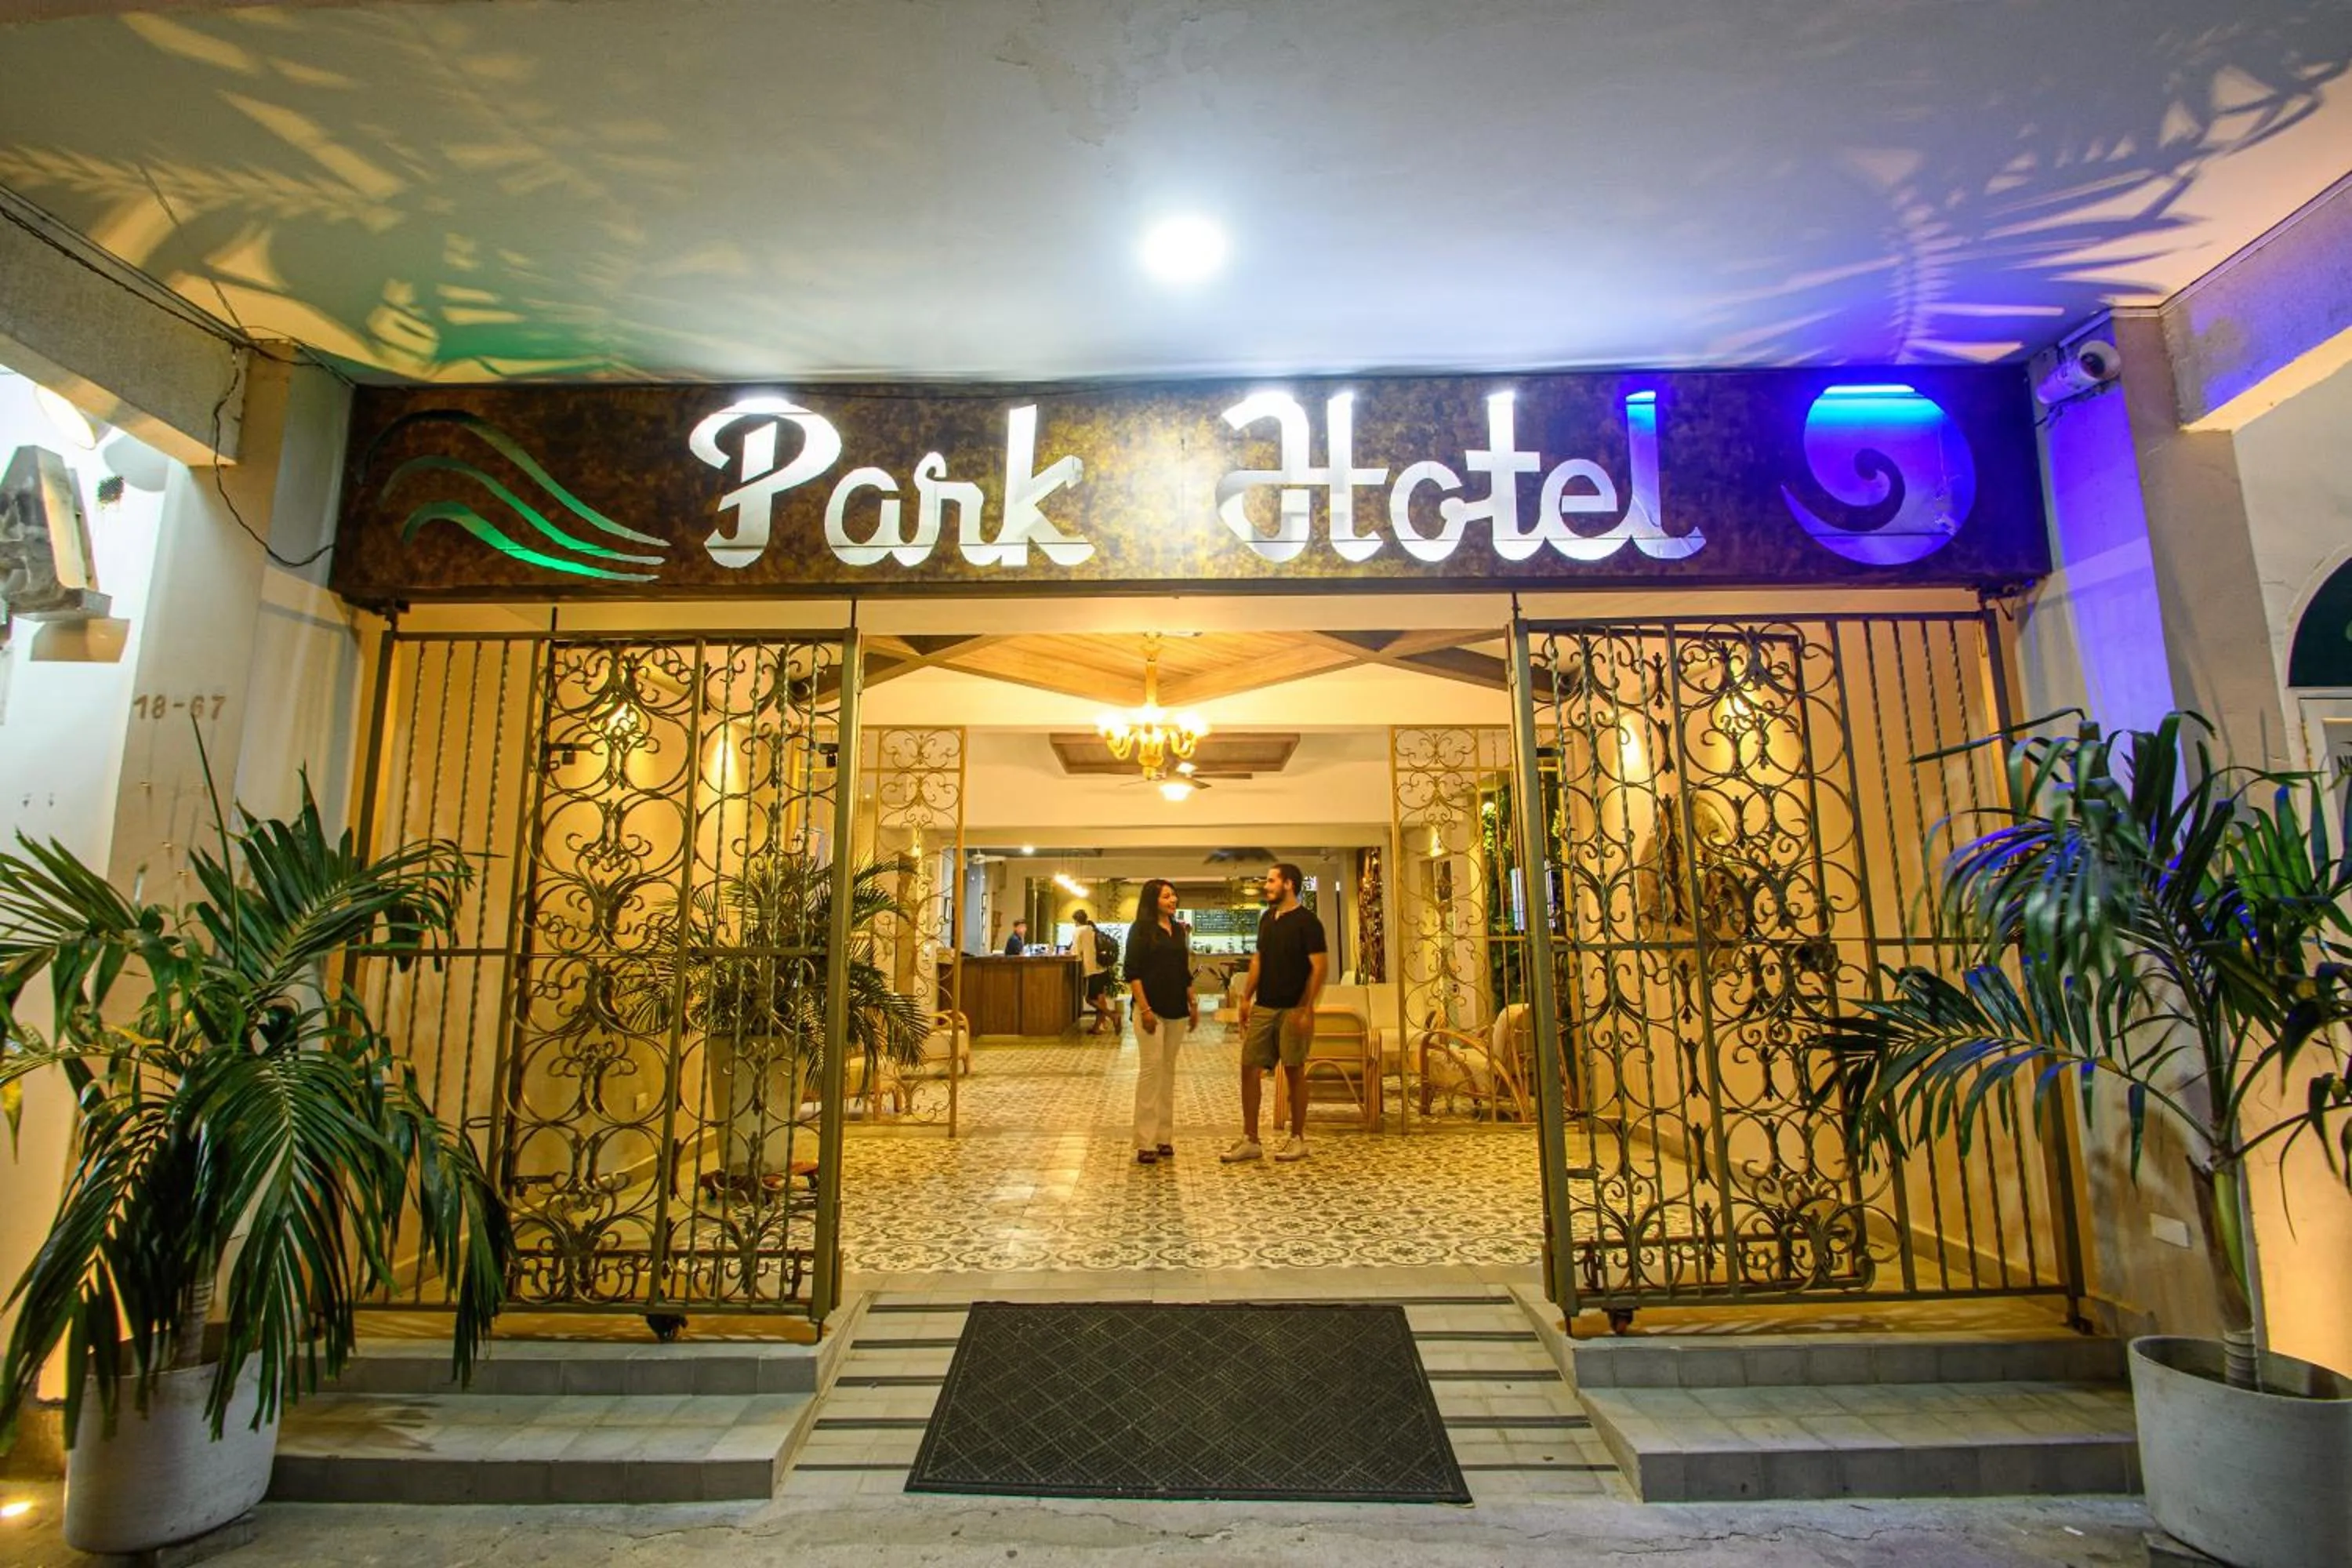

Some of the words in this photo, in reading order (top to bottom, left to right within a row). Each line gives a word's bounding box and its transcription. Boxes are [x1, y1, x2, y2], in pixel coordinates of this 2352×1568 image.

[689, 396, 1096, 568] Park
[1215, 390, 1708, 562] Hotel
[133, 695, 227, 720] 18-67
